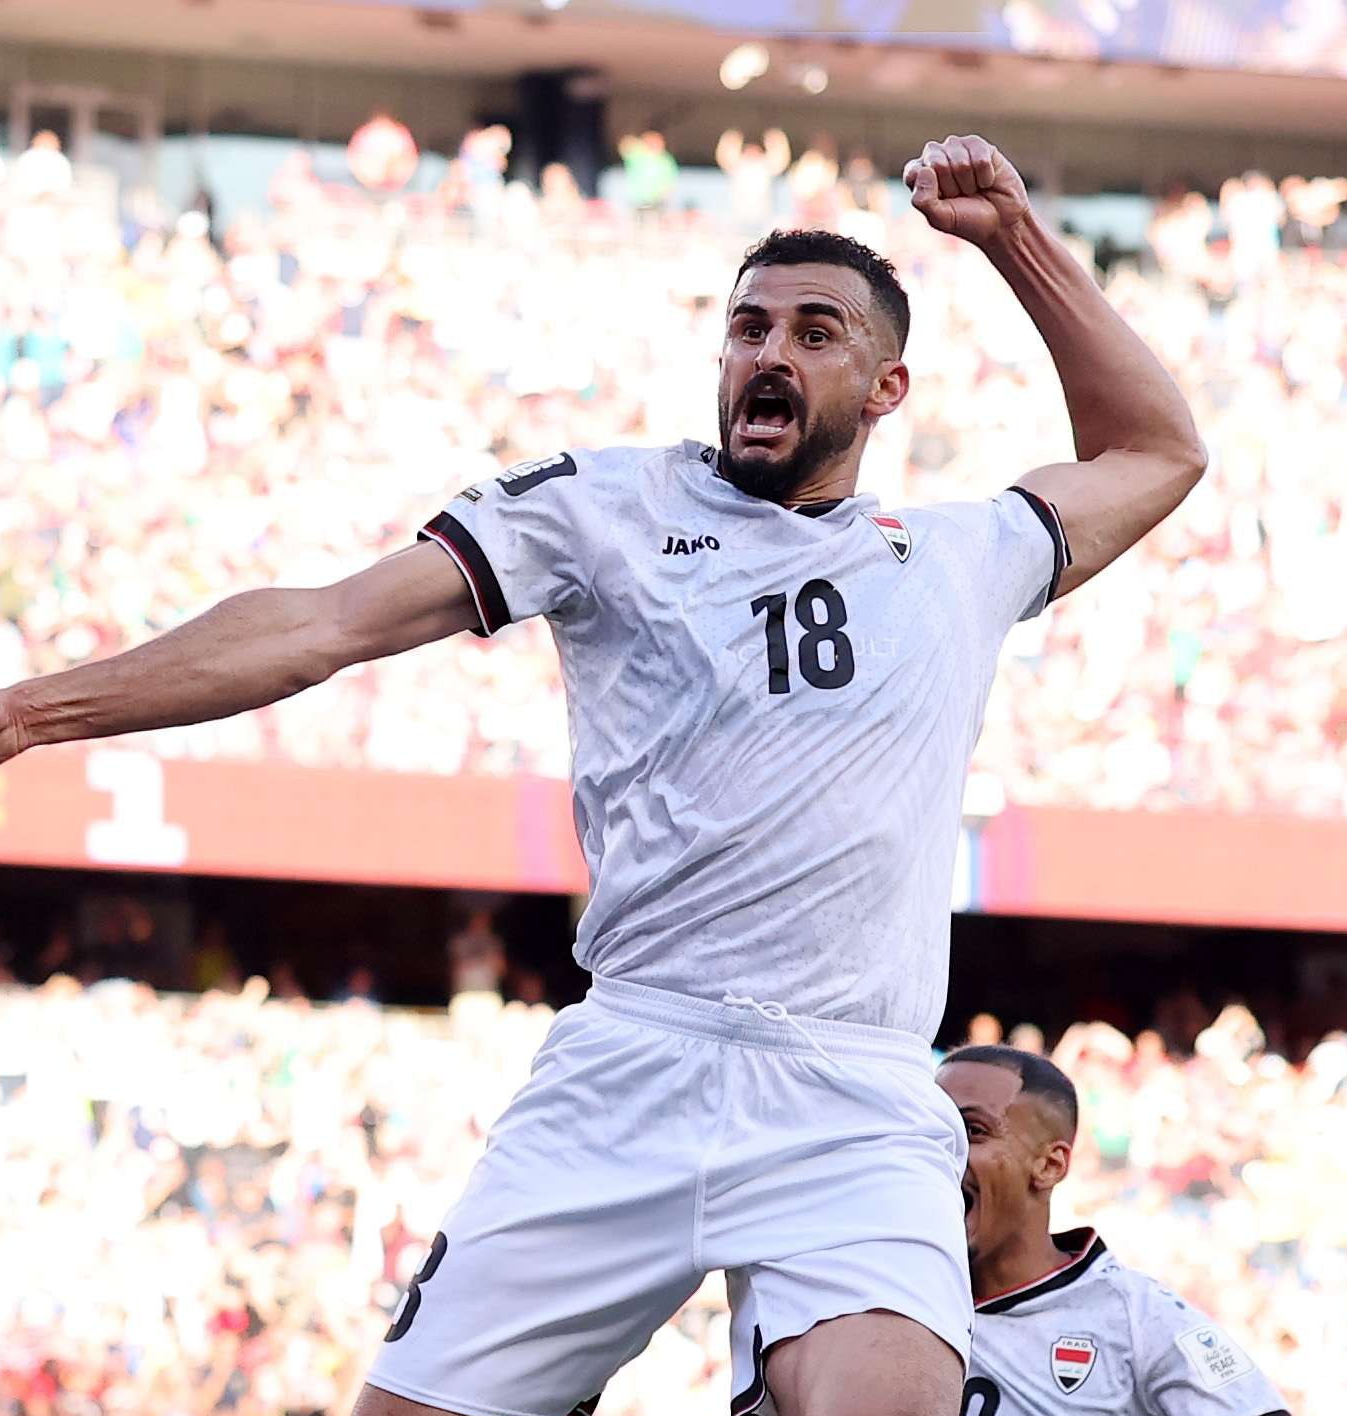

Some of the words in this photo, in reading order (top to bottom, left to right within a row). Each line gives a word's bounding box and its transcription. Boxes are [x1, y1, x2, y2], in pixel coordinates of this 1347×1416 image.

[662, 534, 721, 556] JAKO
[750, 578, 855, 695] 18
[85, 748, 188, 867] 1
